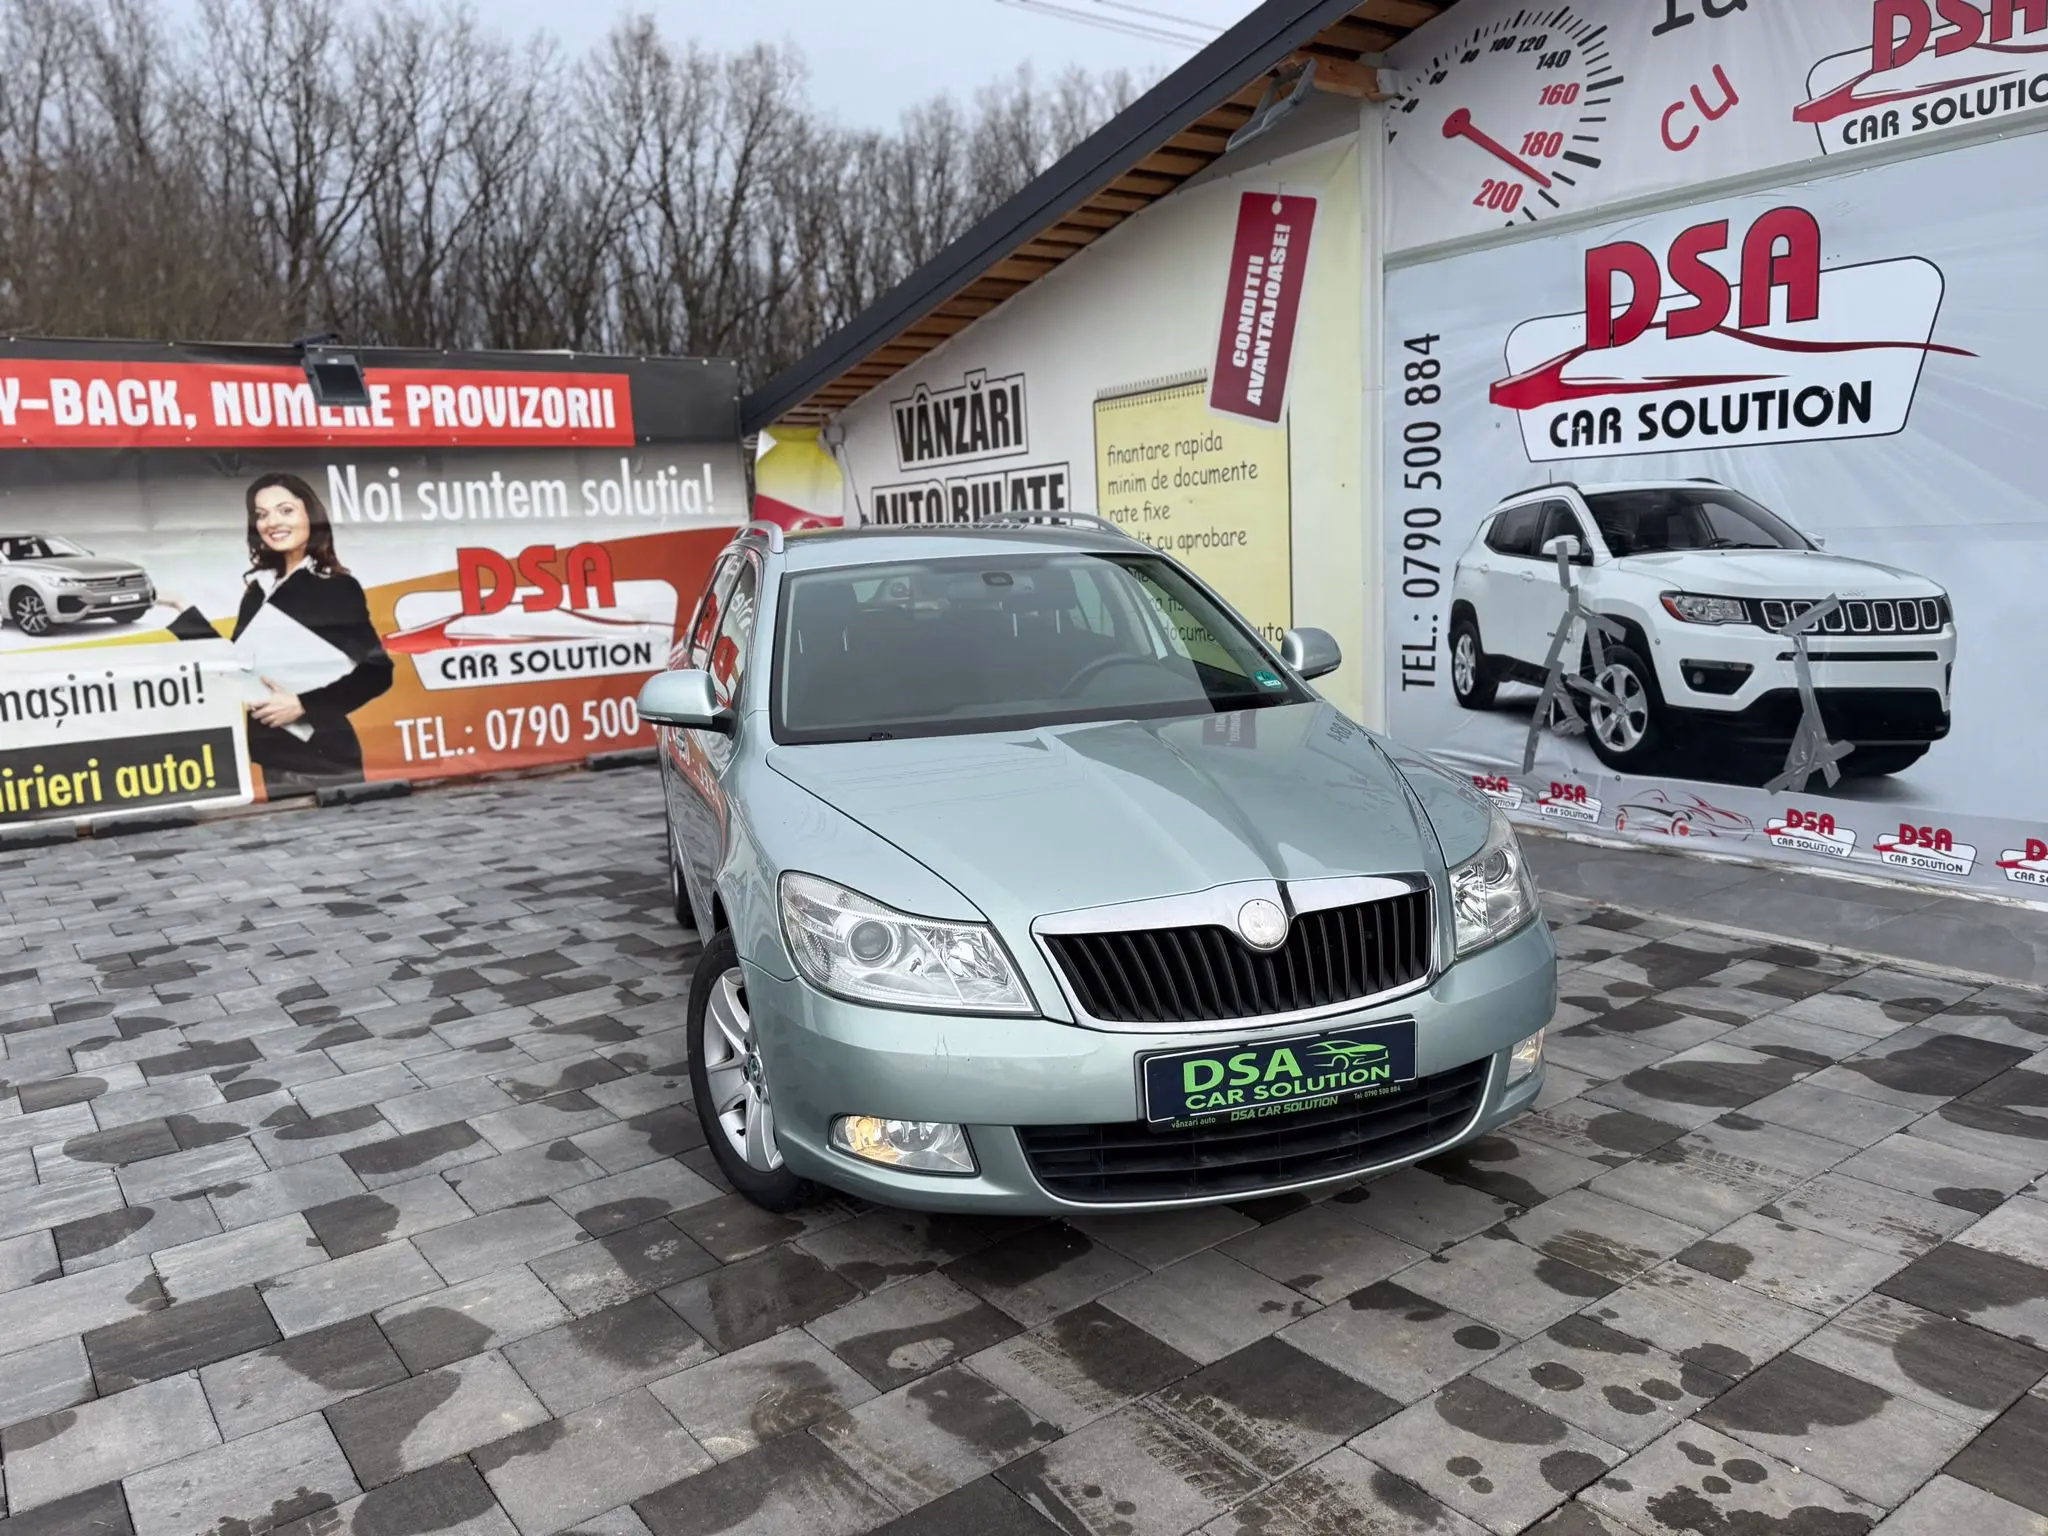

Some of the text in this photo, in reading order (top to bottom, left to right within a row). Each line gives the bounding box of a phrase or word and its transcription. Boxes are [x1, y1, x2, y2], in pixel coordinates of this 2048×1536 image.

[1489, 35, 1517, 53] 100
[1516, 34, 1548, 54] 120
[1536, 50, 1571, 70] 140
[1538, 83, 1580, 105] 160
[1661, 63, 1740, 152] cu
[1519, 131, 1564, 158] 180
[1842, 110, 1899, 145] CAR
[1472, 178, 1523, 213] 200
[1585, 206, 1821, 351] DSA
[1246, 224, 1291, 406] AVANTAJOASE!
[405, 384, 616, 429] PROVIZORII
[896, 378, 1025, 463] VÂNZĂRI
[1549, 380, 1873, 448] CAR SOLUTION
[1174, 430, 1223, 461] rapida
[327, 465, 402, 523] Noi
[417, 471, 569, 522] suntem
[1107, 461, 1258, 495] minim de documente
[1109, 500, 1171, 524] rate fixe
[1401, 333, 1442, 692] TEL.: 0790 500 884
[1157, 535, 1173, 551] cu
[1177, 526, 1247, 555] aprobare
[457, 542, 617, 616] DSA
[441, 642, 652, 680] CAR SOLUTION
[133, 661, 205, 710] noi!
[394, 696, 640, 762] TEL.: 0790 500
[115, 744, 216, 799] auto!
[1551, 781, 1587, 803] DSA
[1560, 808, 1594, 821] SOLUTION
[1786, 808, 1835, 835] DSA
[1777, 837, 1844, 855] CAR SOLUTION
[1899, 823, 1952, 852] DSA
[1889, 855, 1963, 873] CAR SOLUTION
[2014, 871, 2035, 882] CAR
[1183, 1047, 1302, 1094] DSA
[1185, 1064, 1391, 1110] CAR SOLUTION
[1230, 1096, 1339, 1122] DSA CAR SOLUTION
